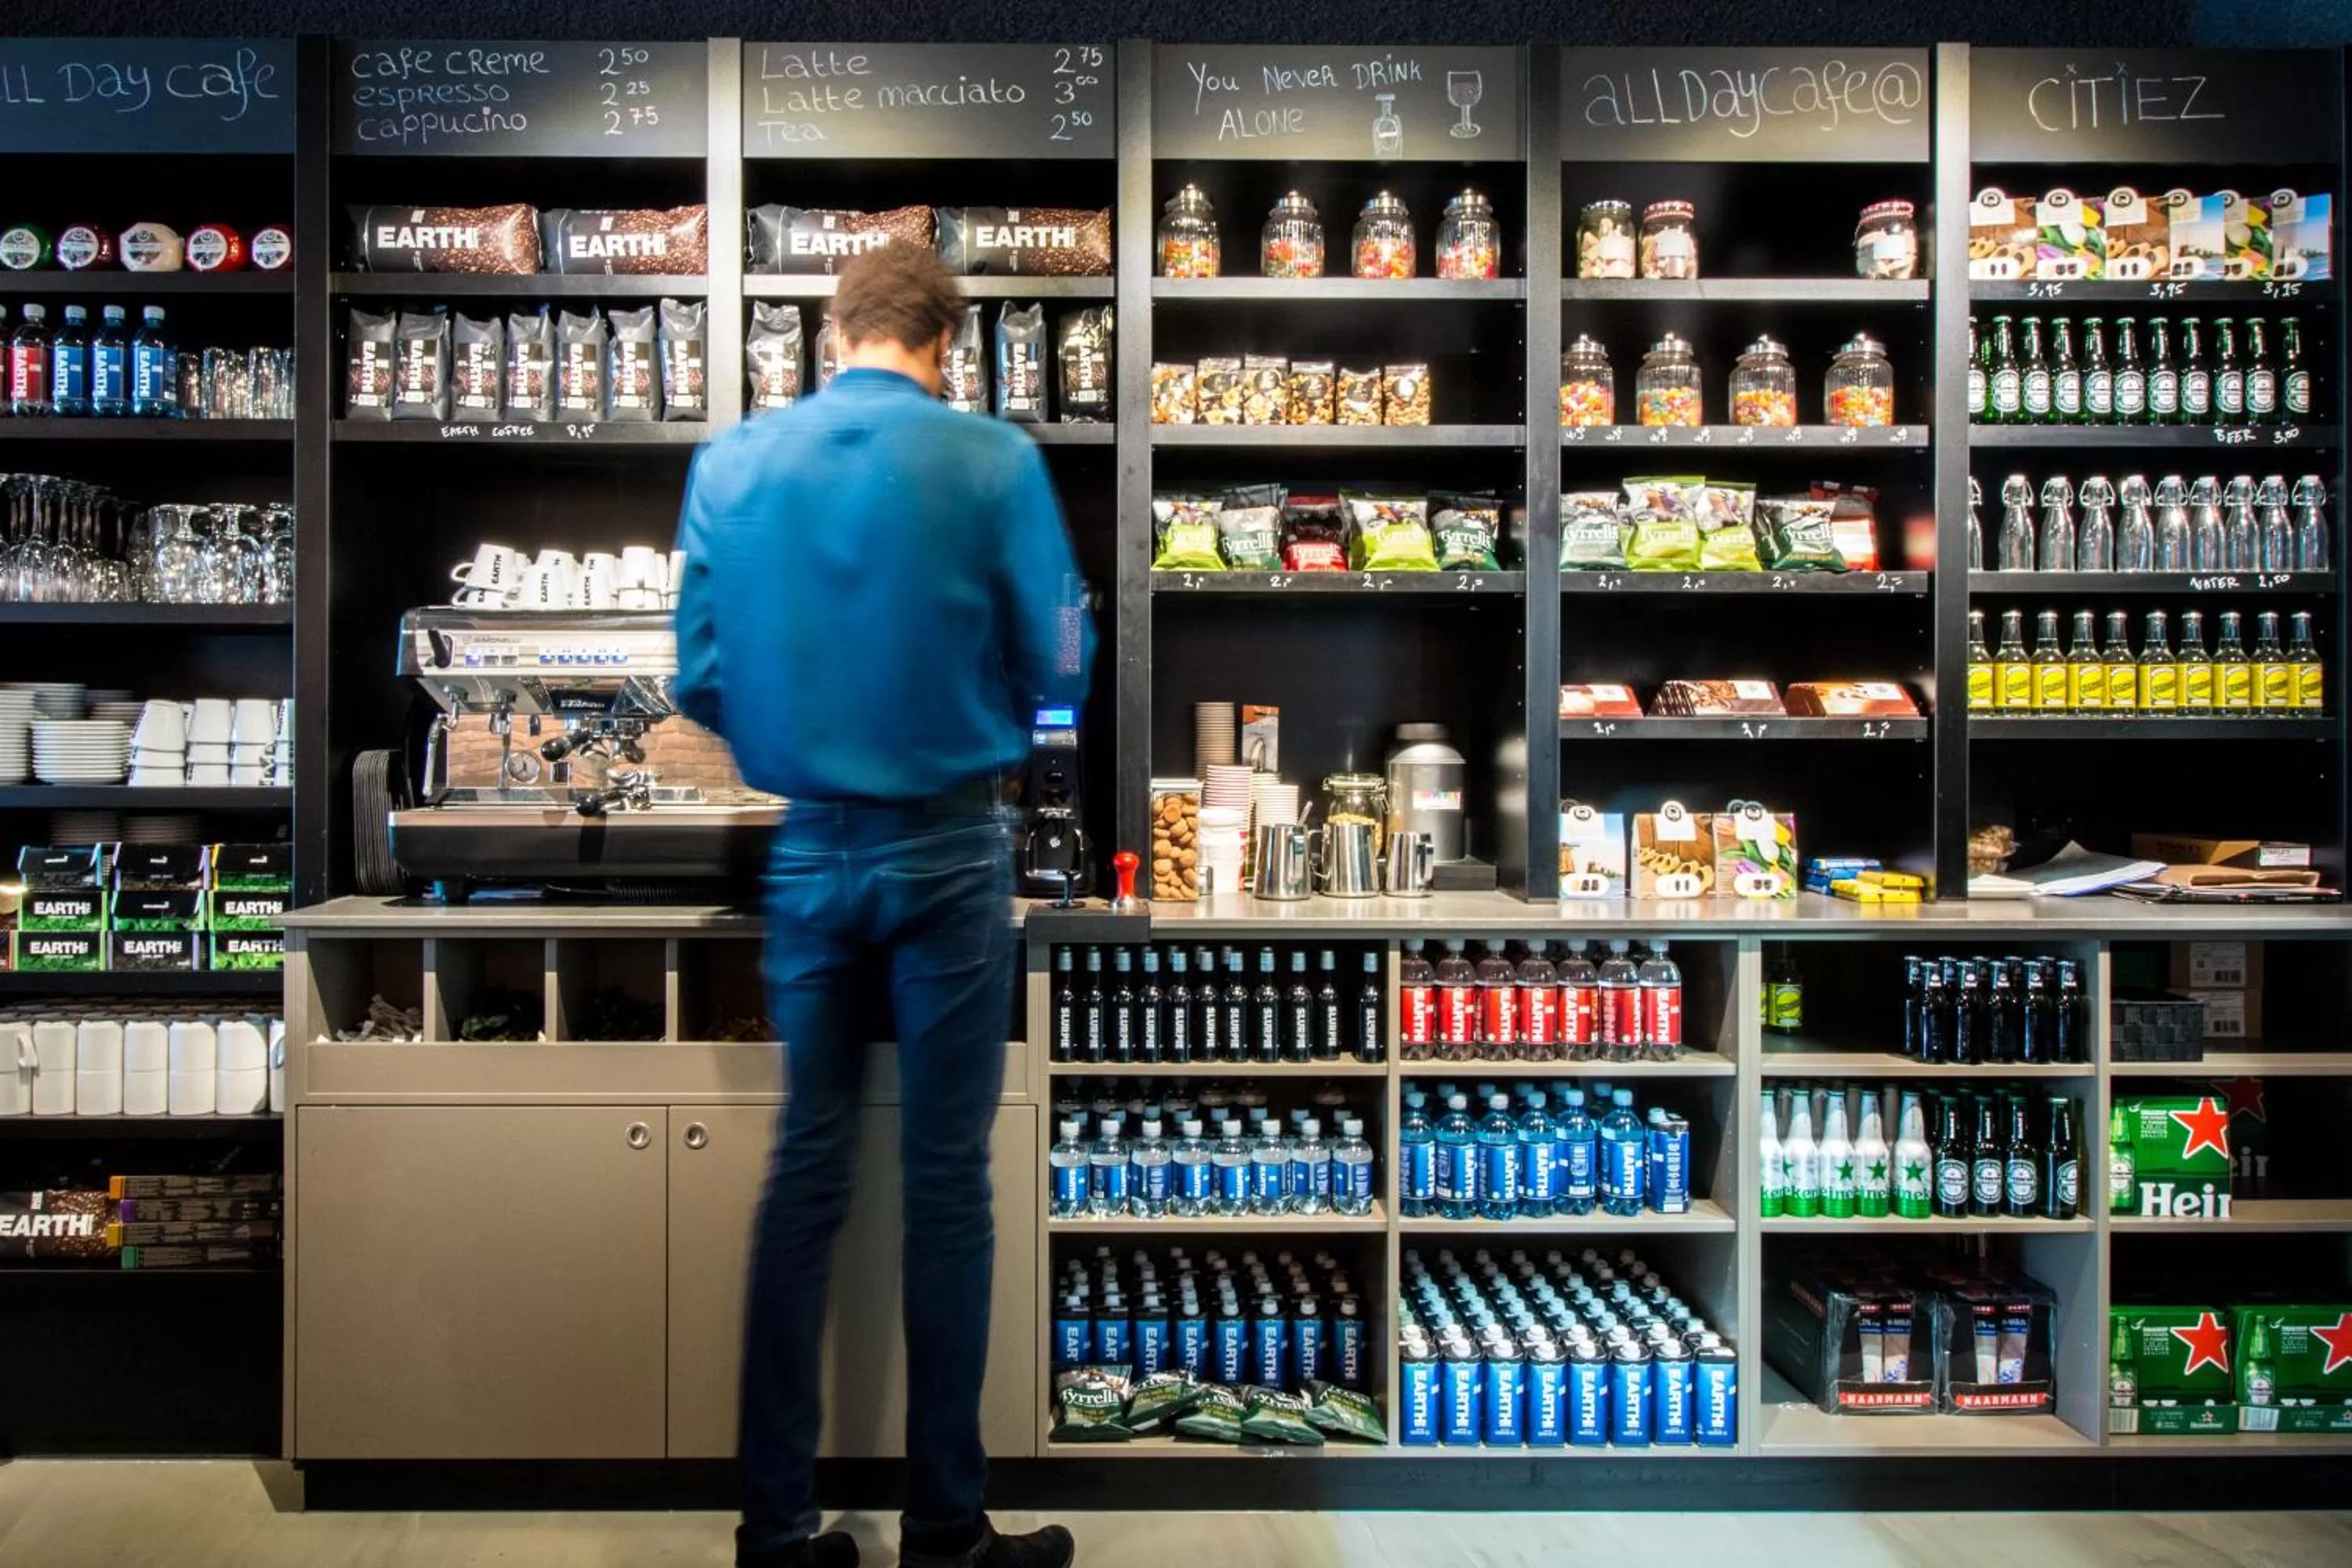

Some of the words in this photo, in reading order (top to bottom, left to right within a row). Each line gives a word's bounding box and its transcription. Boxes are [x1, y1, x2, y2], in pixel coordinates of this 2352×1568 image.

[2, 64, 45, 103] LL
[56, 62, 151, 113] Day
[166, 47, 280, 121] cafe
[761, 49, 873, 79] Latte
[763, 83, 866, 114] Latte
[1187, 62, 1240, 116] You
[357, 106, 528, 147] cappucino
[757, 121, 828, 148] Tea
[377, 226, 474, 249] EARTH
[570, 232, 660, 260] EARTH
[790, 232, 887, 256] EARTH
[976, 227, 1071, 249] EARTH
[15, 350, 27, 397] EARTH
[56, 350, 68, 397] EARTH
[94, 350, 107, 397] EARTH
[139, 349, 151, 397] EARTH
[492, 424, 535, 437] COFFEE
[2213, 427, 2256, 445] BEER
[491, 554, 502, 584] EARTH
[34, 901, 85, 916] EARTH
[225, 901, 276, 916] EARTH
[30, 942, 82, 955] EARTH
[124, 941, 176, 954] EARTH
[1414, 988, 1425, 1042] EARTH
[1453, 988, 1464, 1042] EARTH
[1500, 988, 1511, 1042] EARTH
[1532, 988, 1543, 1042] EARTH
[1566, 988, 1577, 1042] EARTH
[1657, 988, 1669, 1042] EARTH
[0, 1214, 87, 1236] EARTH
[1067, 1327, 1079, 1361] EAR
[1106, 1327, 1117, 1361] EAR
[1185, 1327, 1197, 1369] EART
[1226, 1327, 1237, 1381] EARTH
[1265, 1327, 1276, 1381] EARTH
[1303, 1327, 1315, 1380] EARTH
[1345, 1327, 1356, 1381] EARTH
[1414, 1370, 1427, 1428] EARTH
[1456, 1370, 1469, 1428] EARTH
[1498, 1370, 1512, 1428] EARTH
[1542, 1370, 1555, 1428] EARTH
[1581, 1370, 1595, 1428] EARTH
[1626, 1370, 1640, 1428] EARTH
[1668, 1368, 1682, 1426] EARTH
[1711, 1370, 1725, 1428] EARTH
